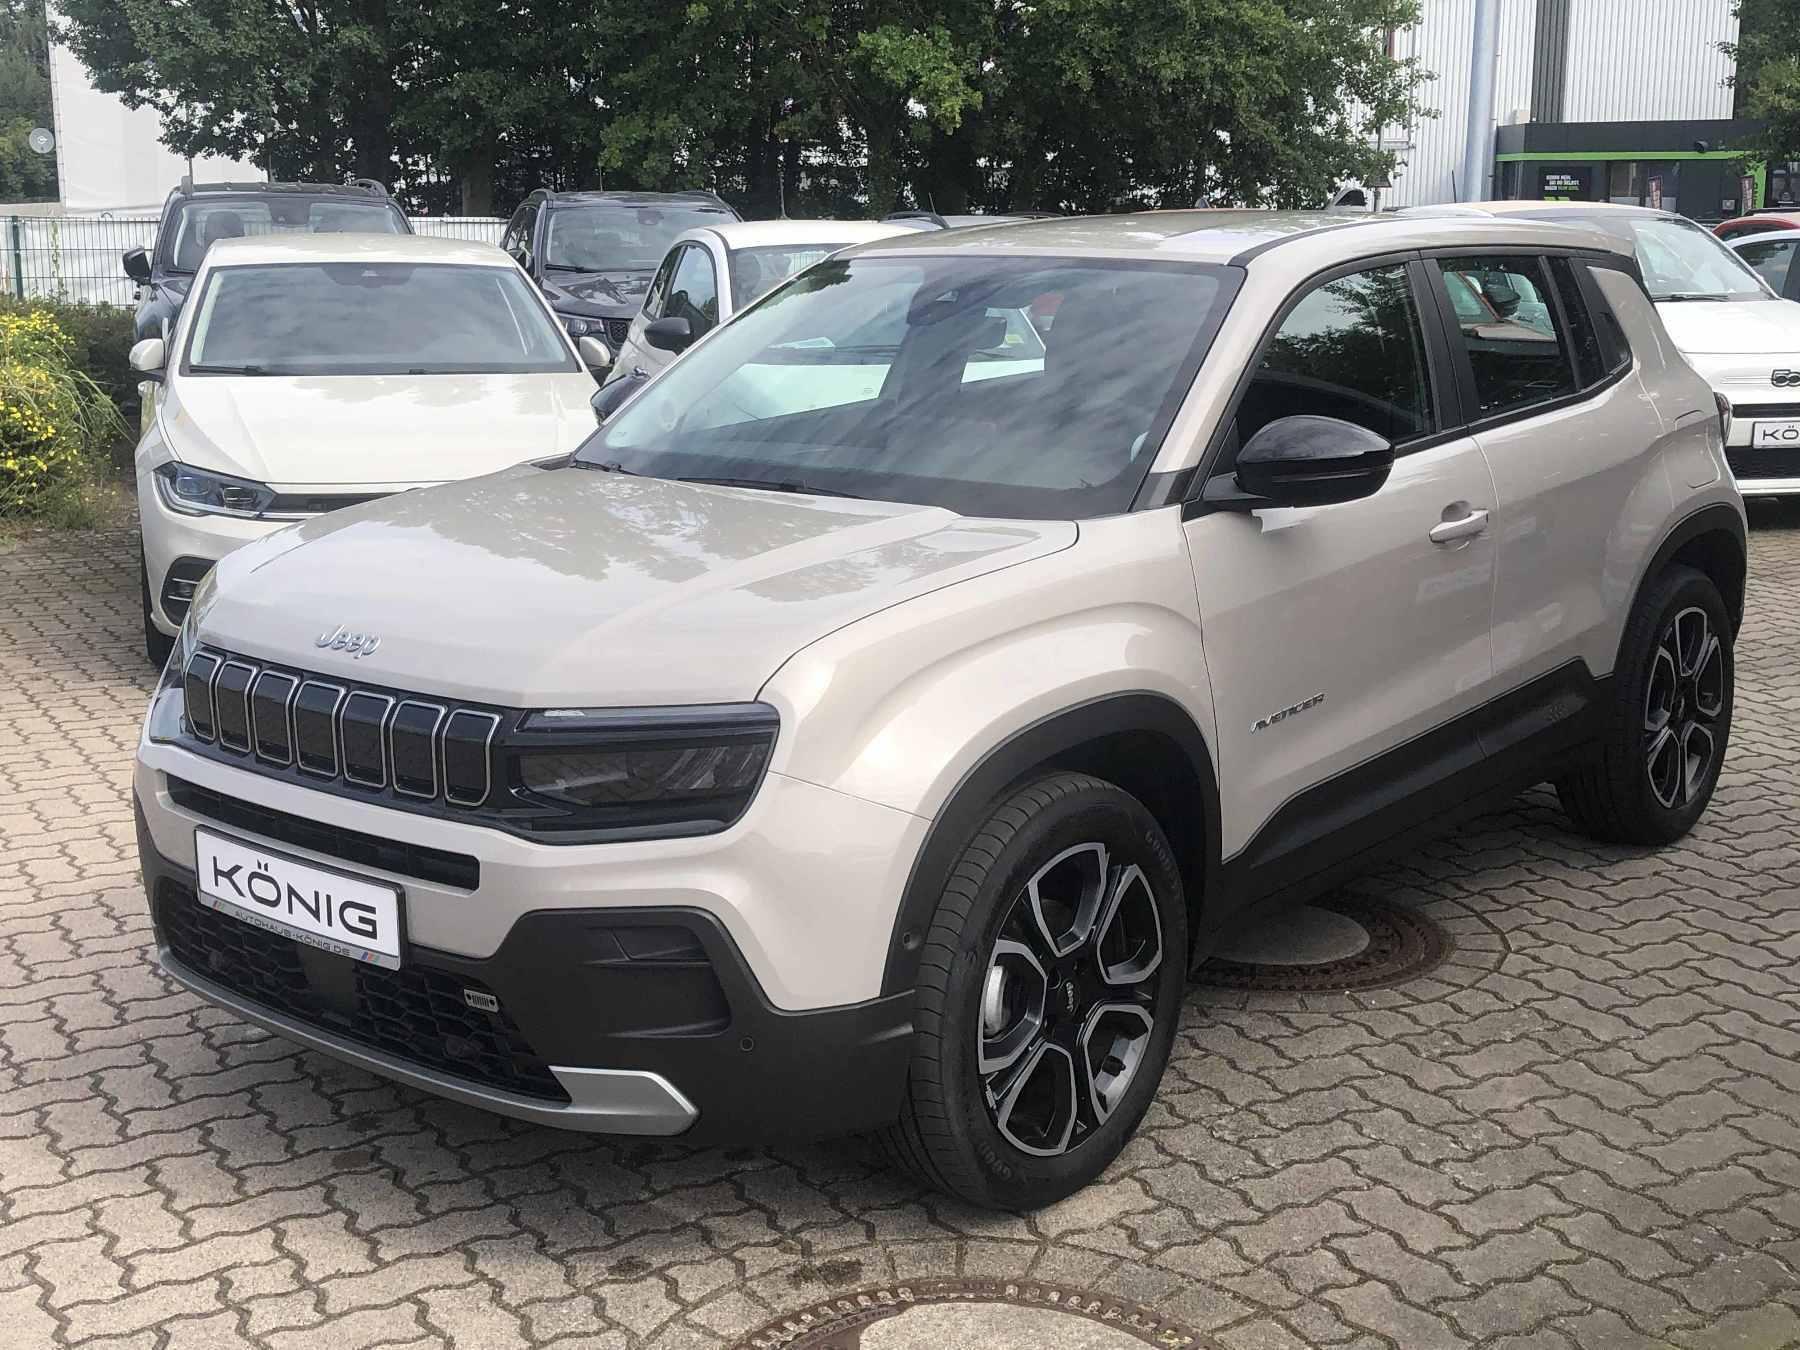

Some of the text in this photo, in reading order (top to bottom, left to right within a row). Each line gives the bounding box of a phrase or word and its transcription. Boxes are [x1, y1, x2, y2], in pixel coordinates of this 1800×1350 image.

[314, 624, 381, 660] Jeep
[1250, 692, 1325, 734] AVENGER
[212, 855, 378, 941] KÖNIG
